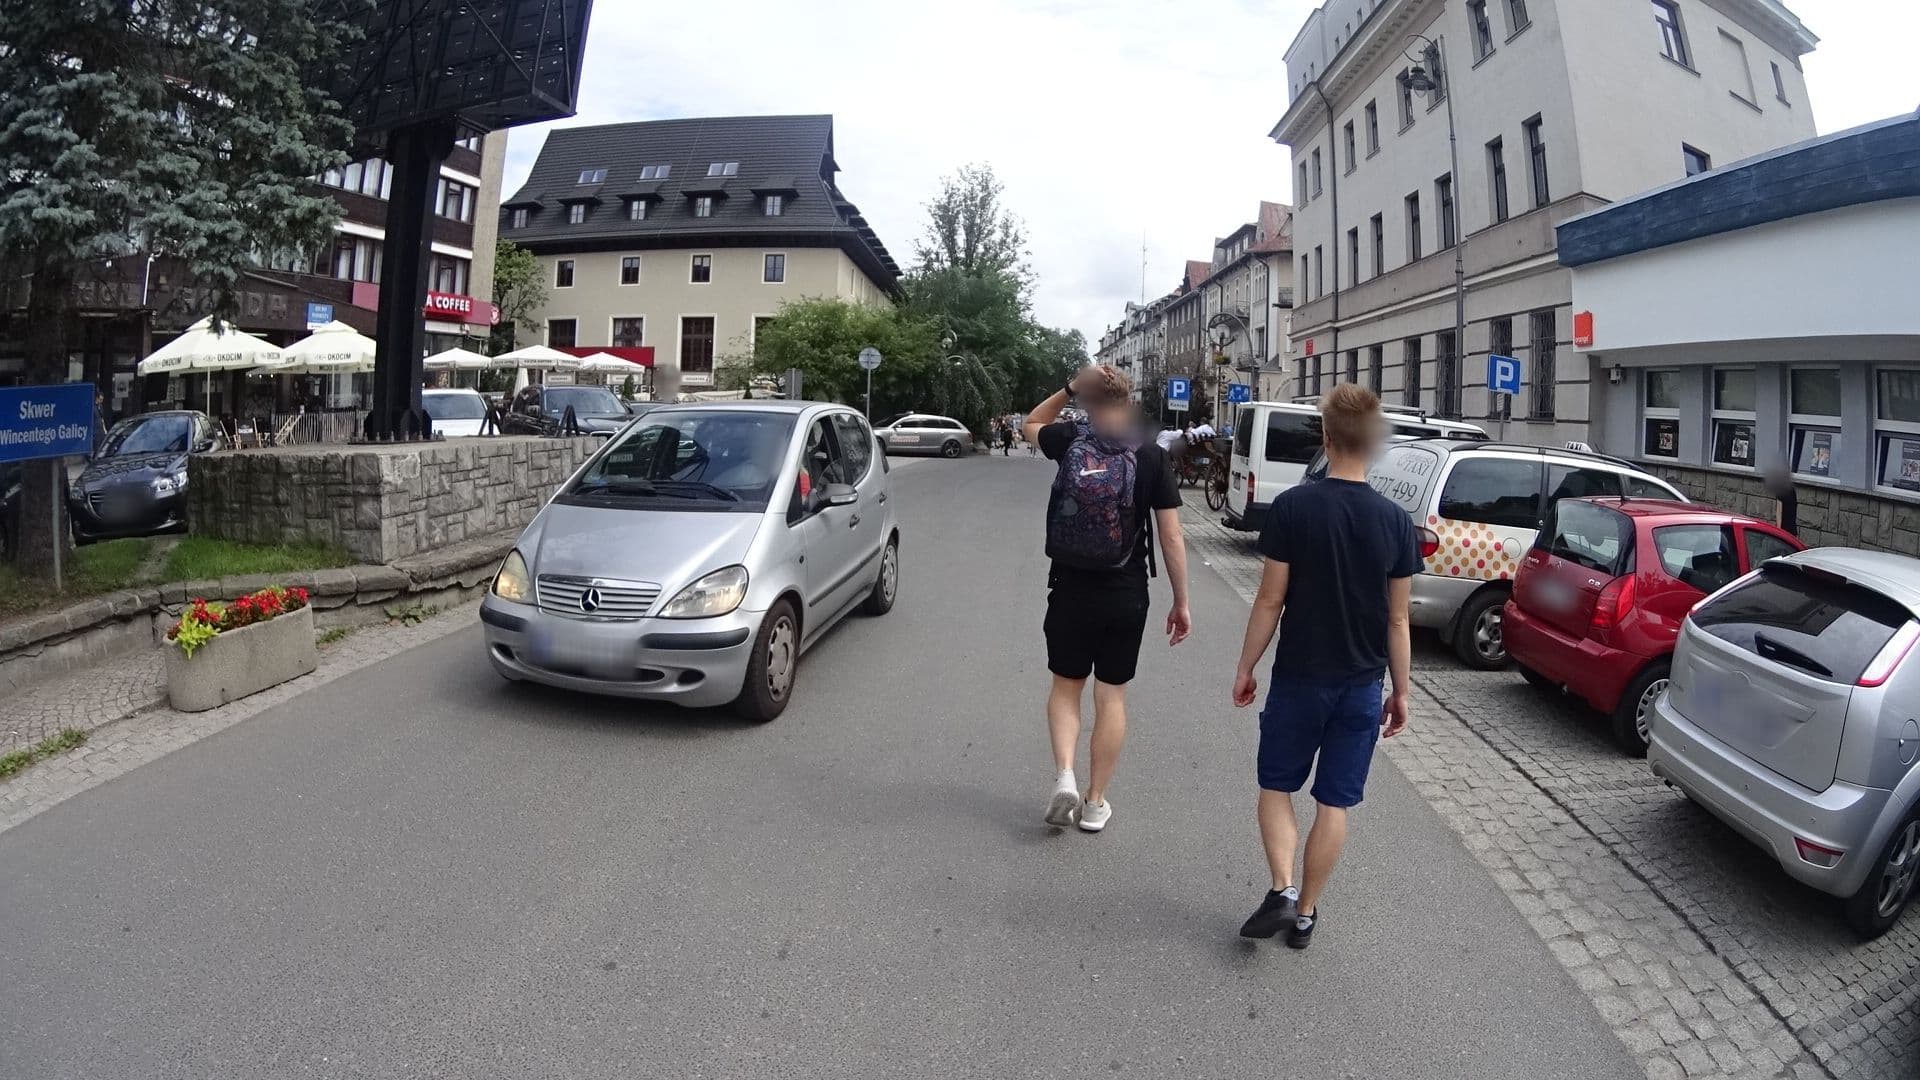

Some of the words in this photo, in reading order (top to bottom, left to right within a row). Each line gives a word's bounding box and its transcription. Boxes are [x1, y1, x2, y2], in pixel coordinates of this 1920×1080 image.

[435, 295, 471, 312] COFFEE
[217, 352, 243, 362] OKOCIM
[327, 352, 352, 361] OKOCIM
[1496, 360, 1514, 388] P
[1173, 380, 1186, 397] P
[20, 400, 56, 420] Skwer
[0, 426, 57, 446] Wincentego
[58, 423, 88, 441] Galicy
[1566, 441, 1583, 451] TAXI
[1392, 479, 1419, 503] 499
